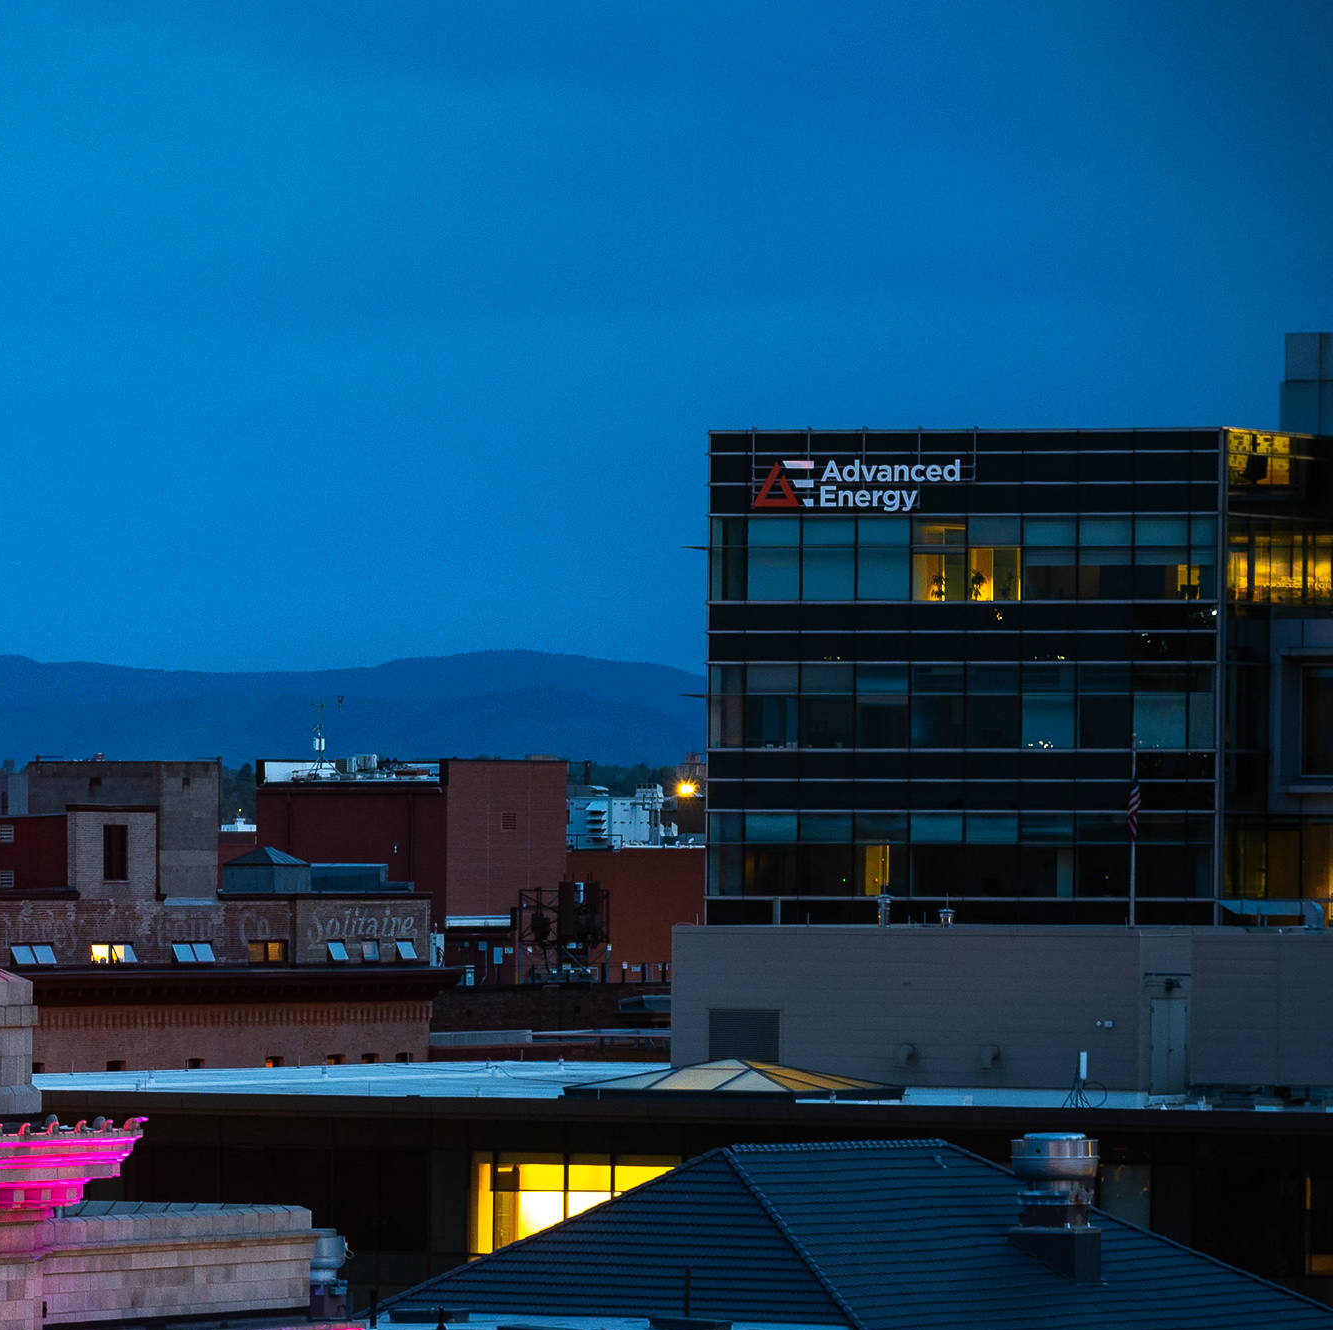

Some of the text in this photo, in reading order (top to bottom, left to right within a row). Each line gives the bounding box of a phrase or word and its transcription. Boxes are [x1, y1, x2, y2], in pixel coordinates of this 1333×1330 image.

[820, 459, 961, 482] Advanced
[819, 485, 918, 512] Energy
[307, 906, 419, 944] Solitaire
